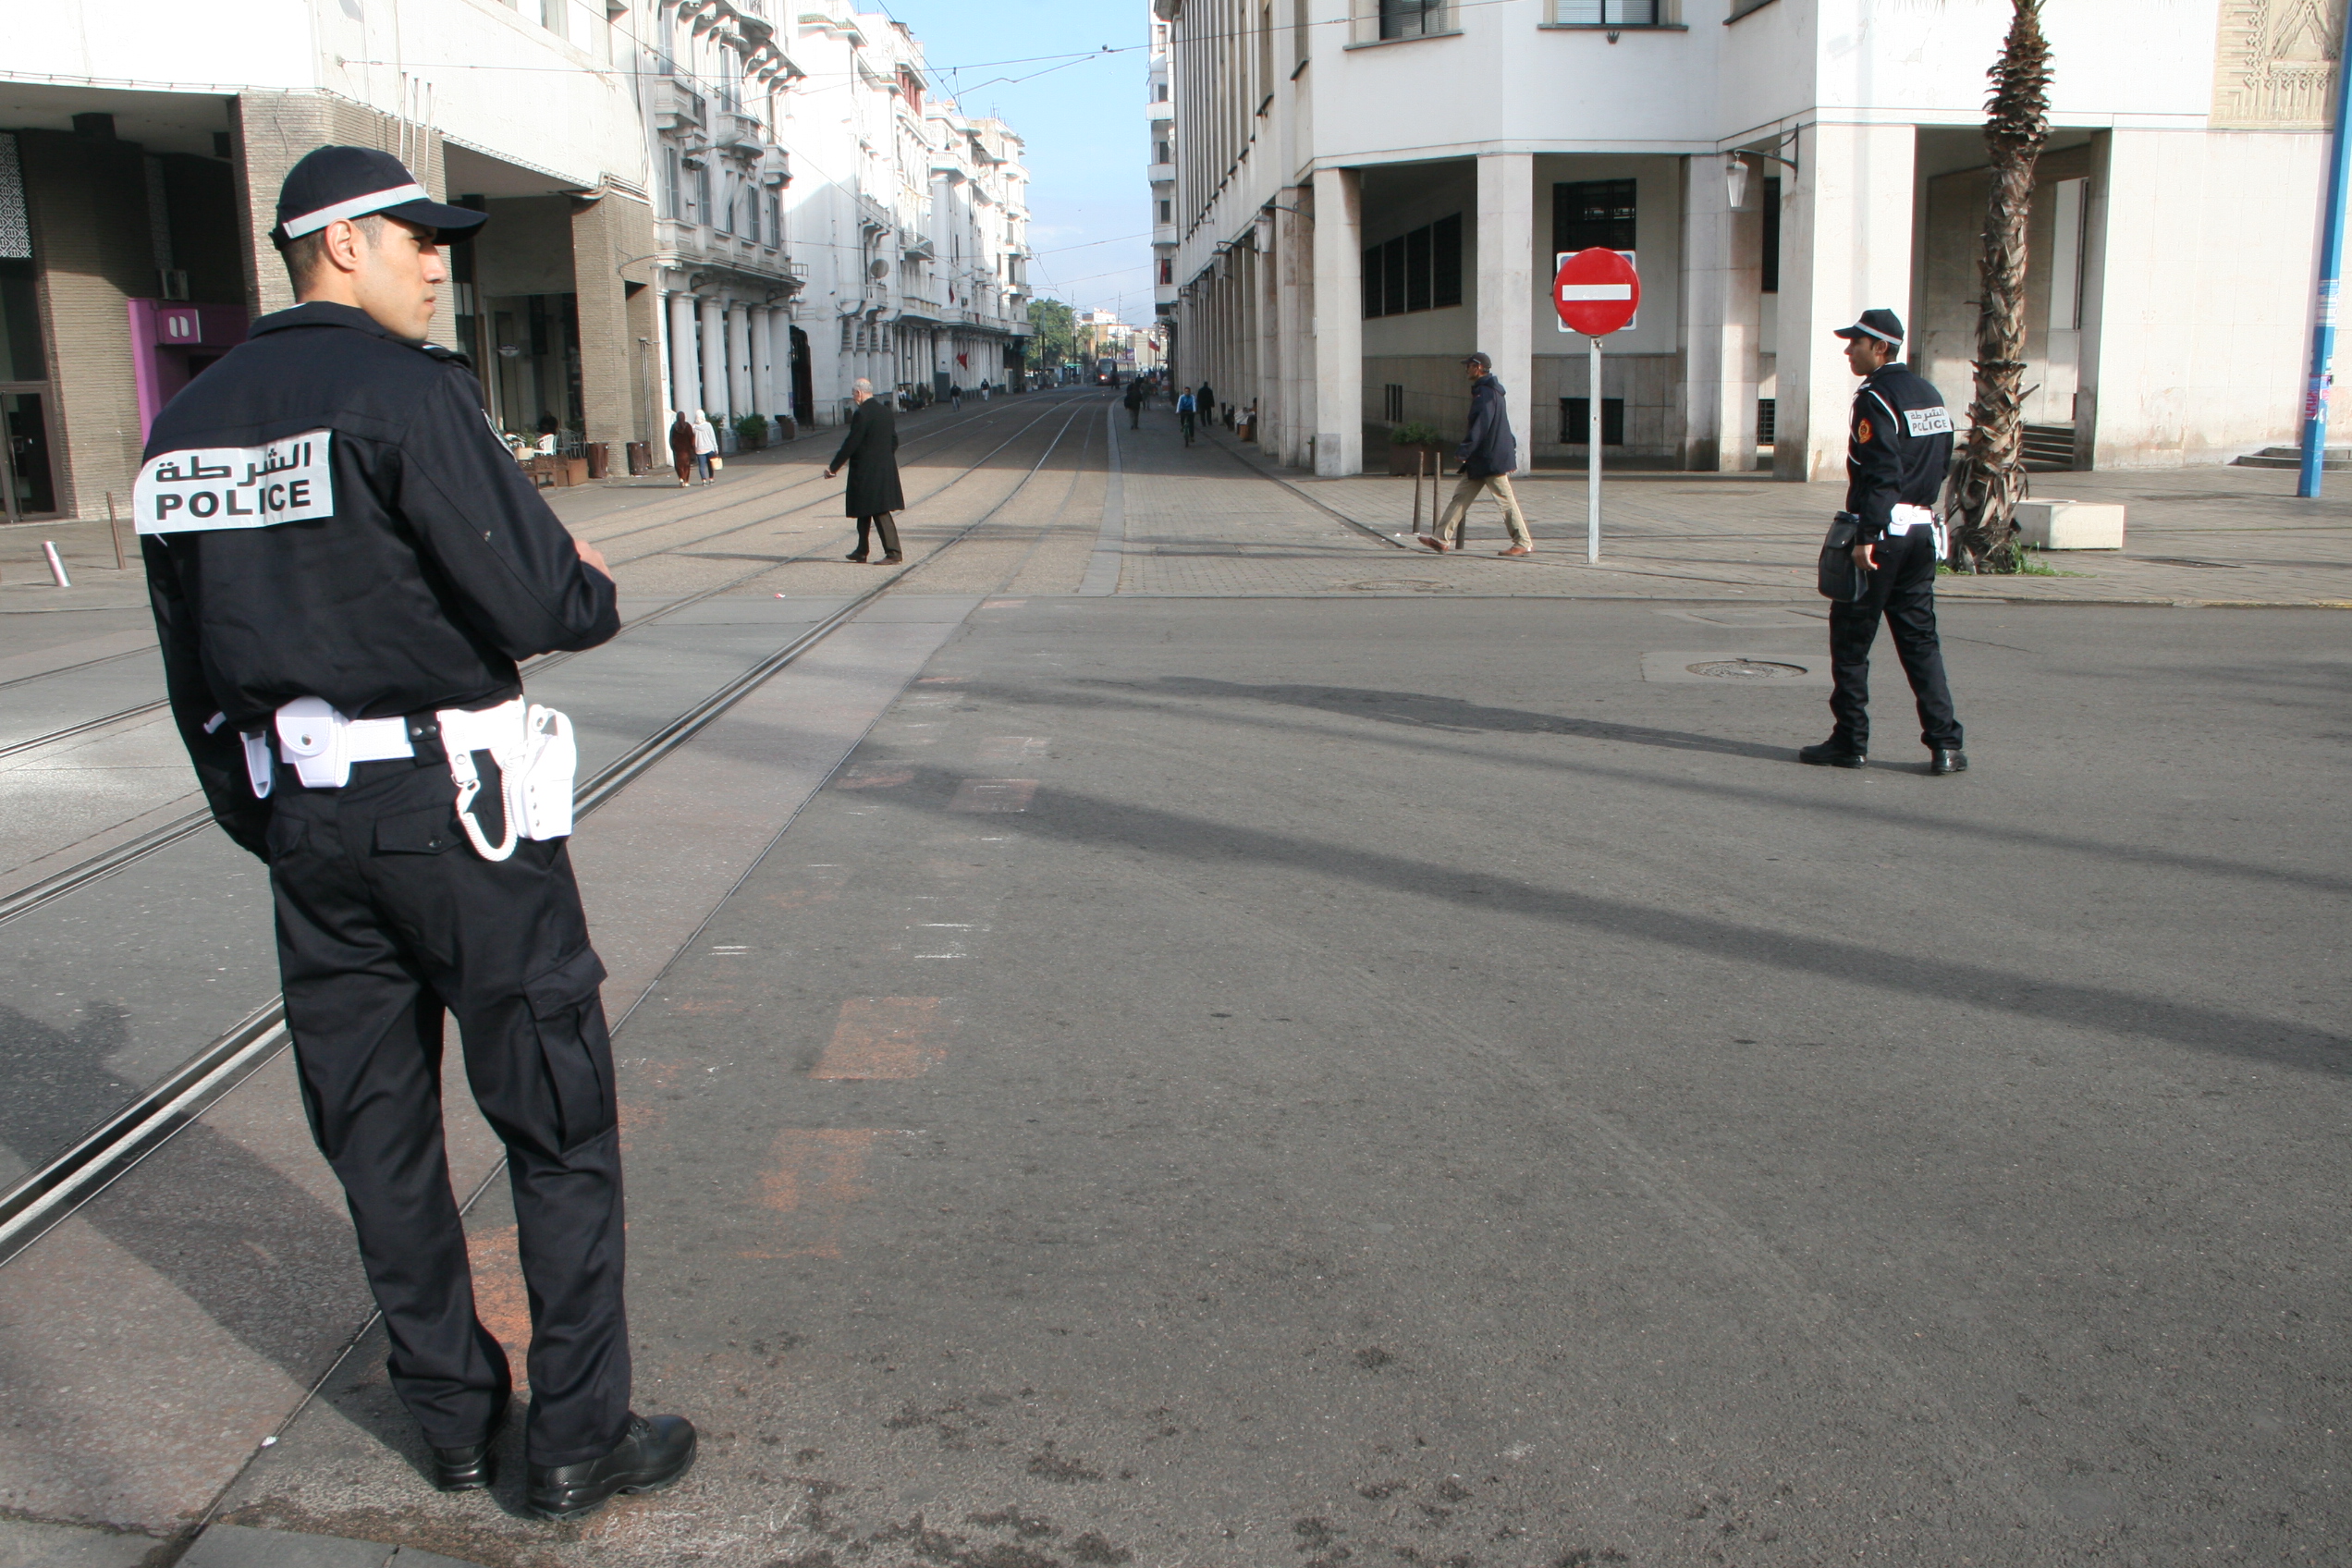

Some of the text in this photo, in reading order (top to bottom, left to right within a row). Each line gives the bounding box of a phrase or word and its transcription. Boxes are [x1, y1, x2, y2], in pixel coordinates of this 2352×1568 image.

[1910, 409, 1944, 422] الشرطة
[1912, 420, 1947, 432] POLICE
[155, 441, 312, 487] الشرطة
[155, 479, 312, 521] POLICE
